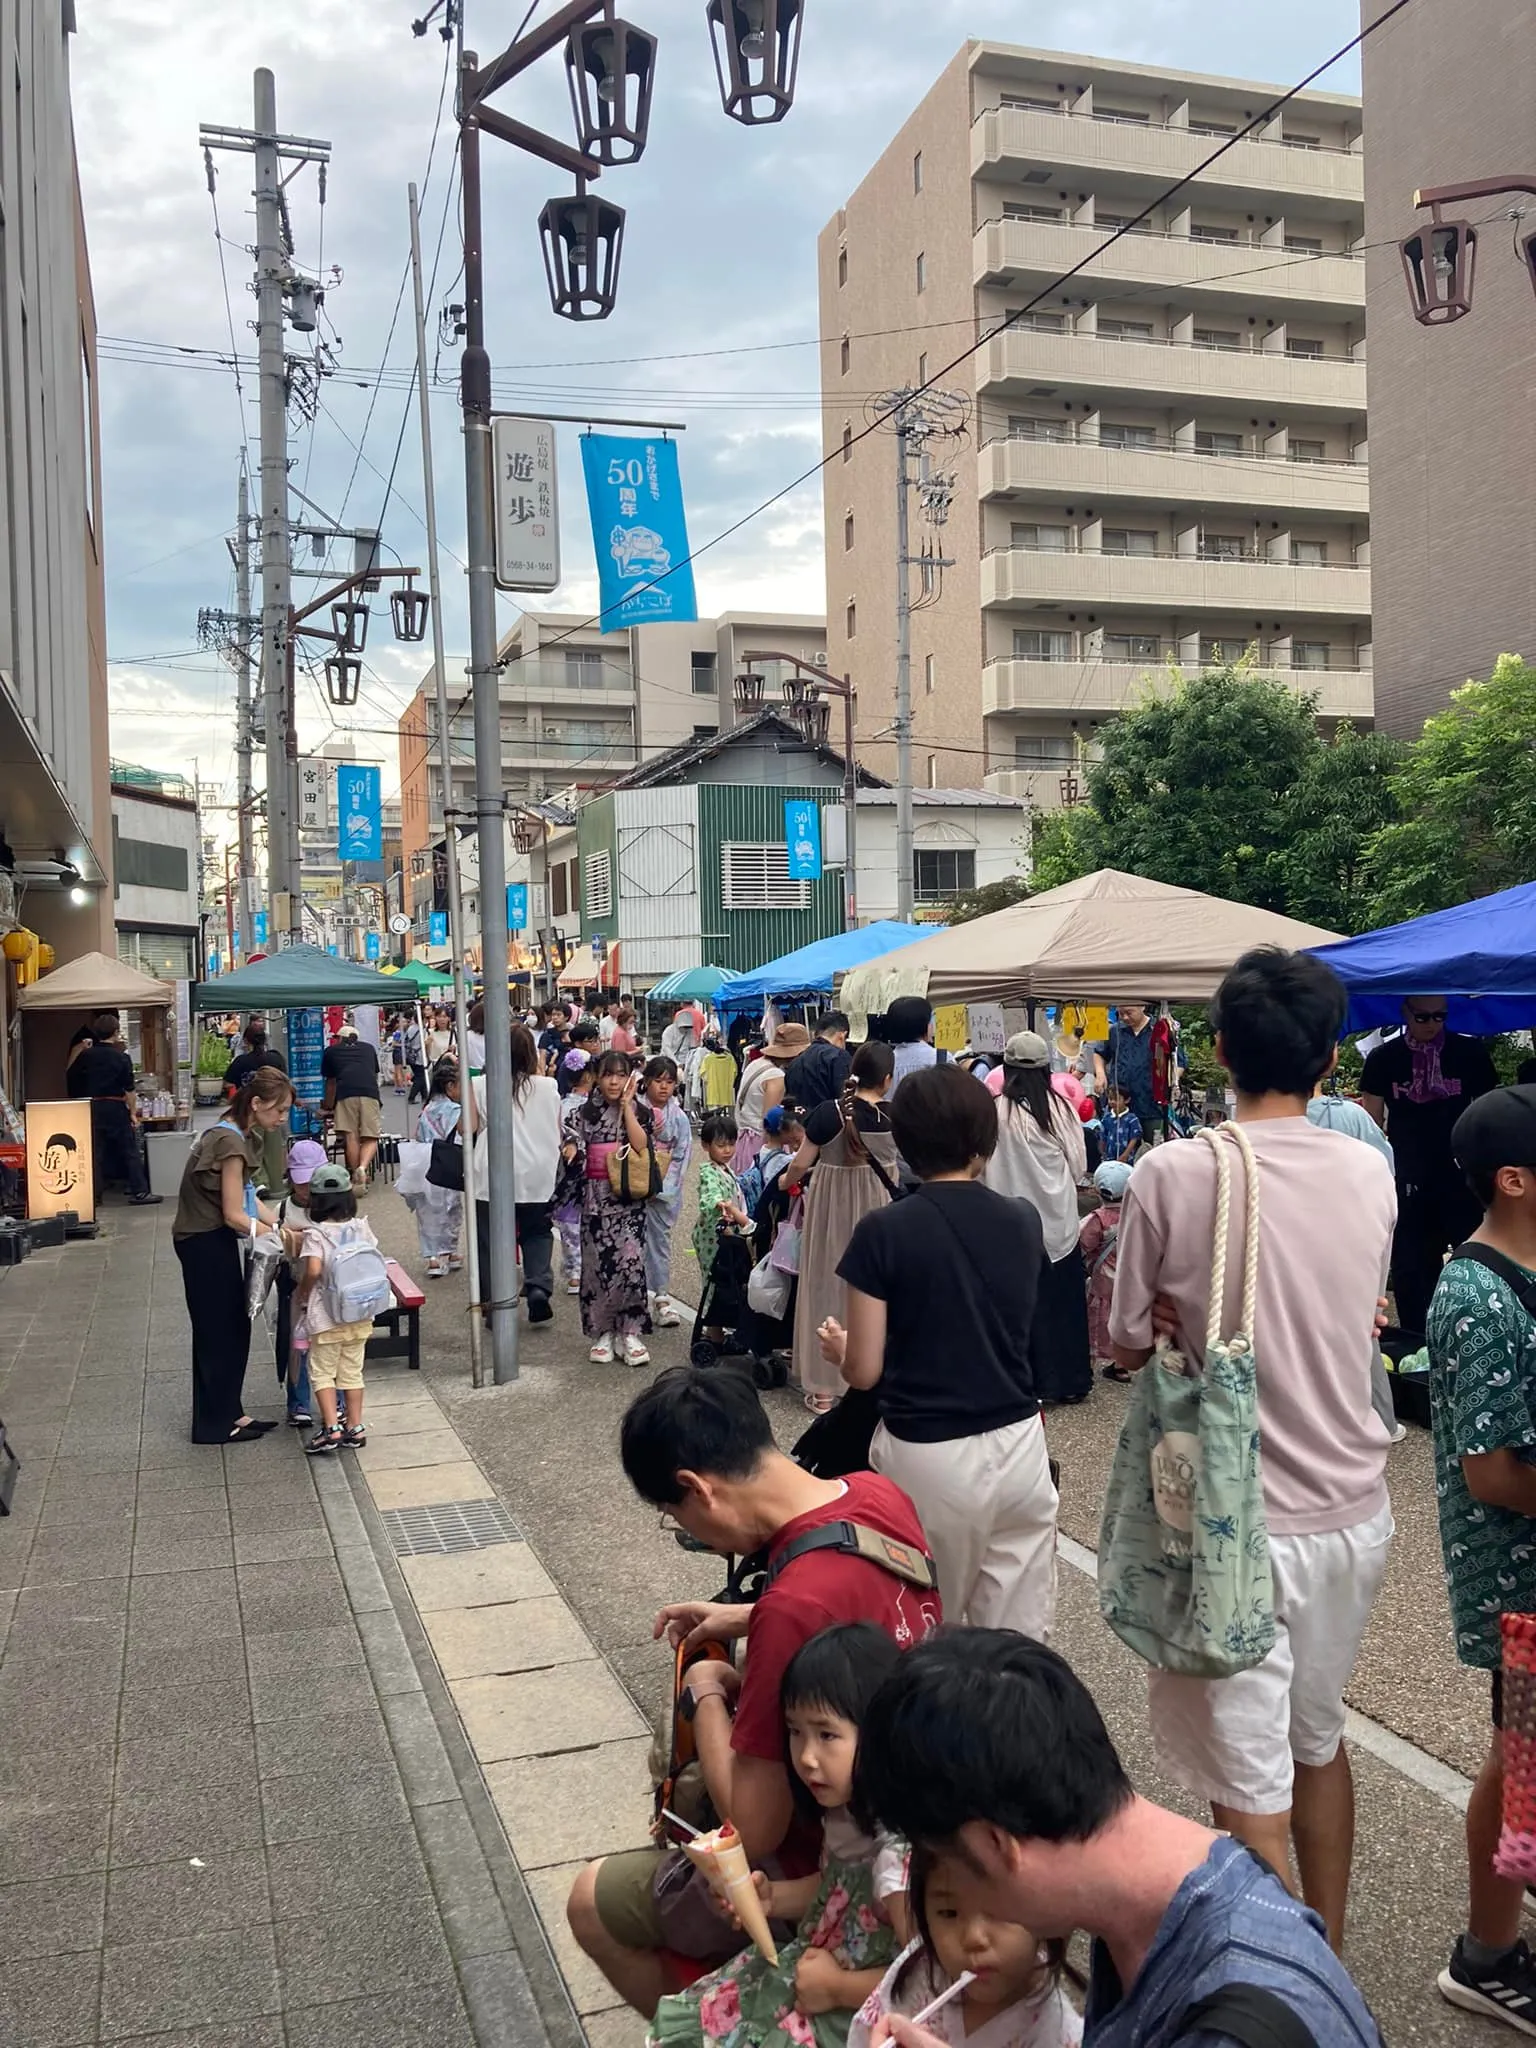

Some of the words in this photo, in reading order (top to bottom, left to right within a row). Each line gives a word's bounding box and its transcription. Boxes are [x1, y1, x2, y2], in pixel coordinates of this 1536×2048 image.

[506, 452, 537, 526] 遊歩
[607, 458, 643, 487] 50
[303, 769, 318, 826] 宮田屋
